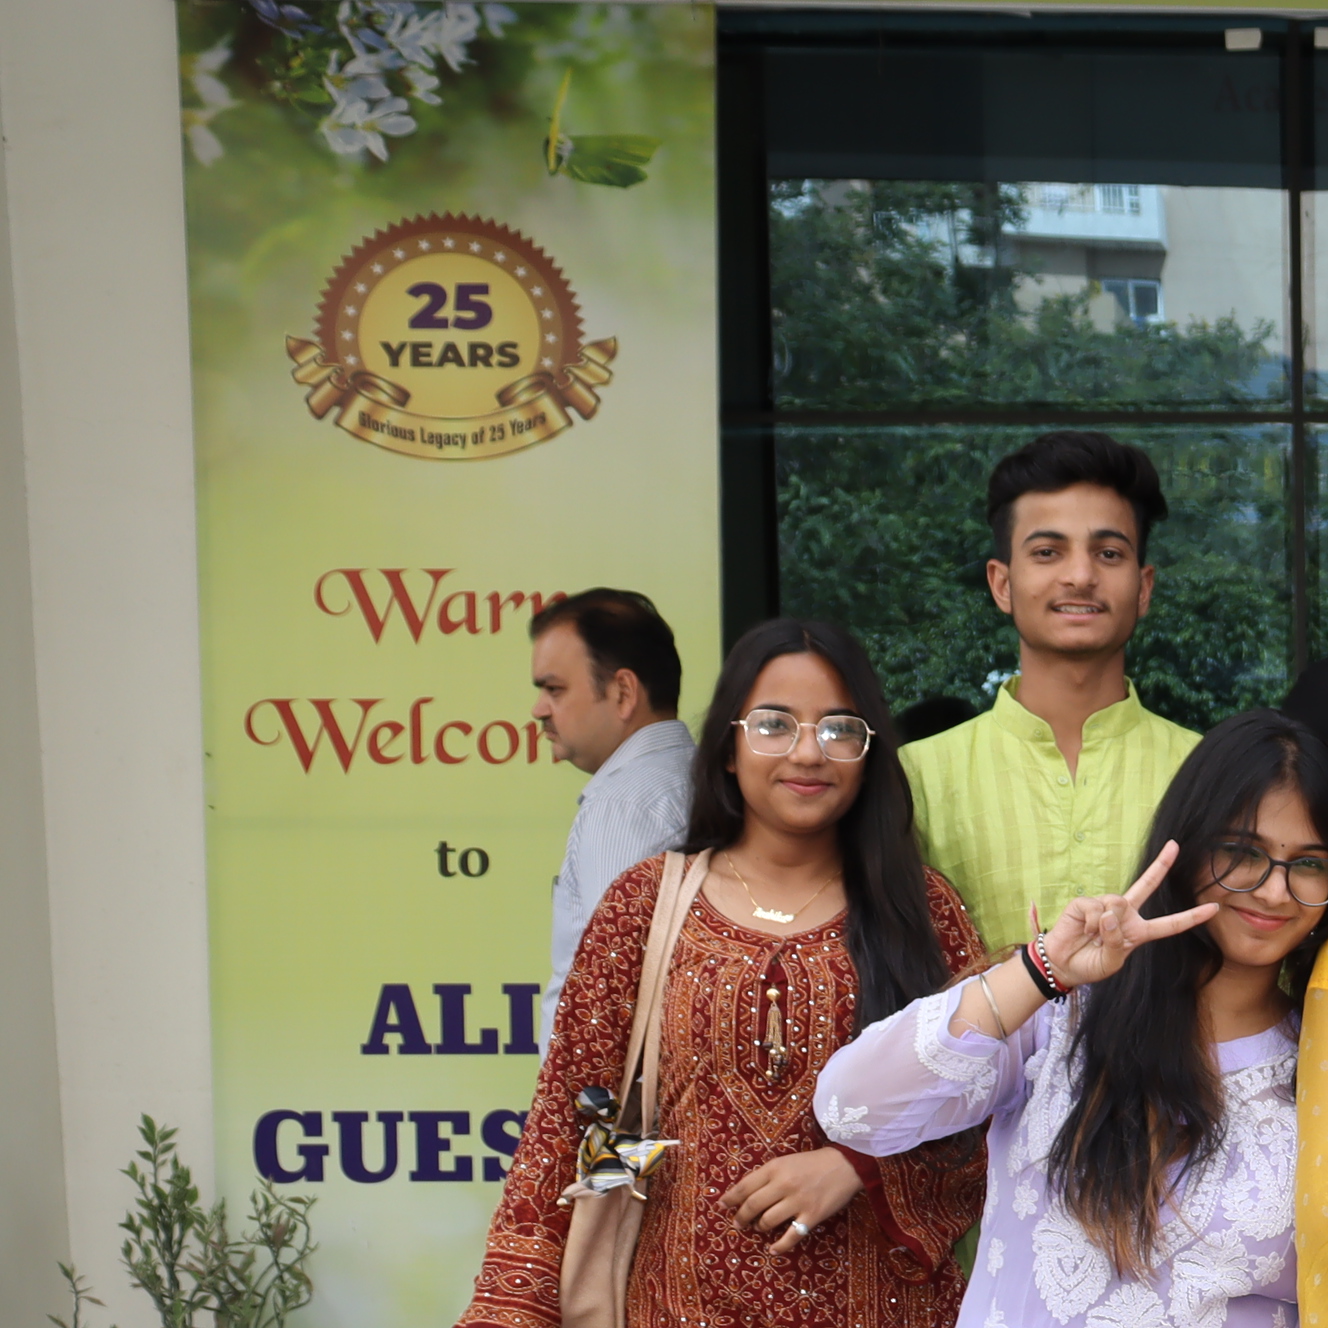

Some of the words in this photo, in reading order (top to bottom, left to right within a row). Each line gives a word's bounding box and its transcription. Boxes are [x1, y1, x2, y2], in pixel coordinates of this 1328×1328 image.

[406, 282, 493, 330] 25
[379, 341, 520, 368] YEARS
[358, 410, 415, 442] Glorious
[420, 426, 466, 449] Legacy
[471, 426, 484, 444] of
[489, 423, 505, 442] 25
[509, 411, 546, 435] Years
[244, 697, 561, 775] Welco
[436, 840, 489, 878] to
[253, 1108, 531, 1184] GUES
